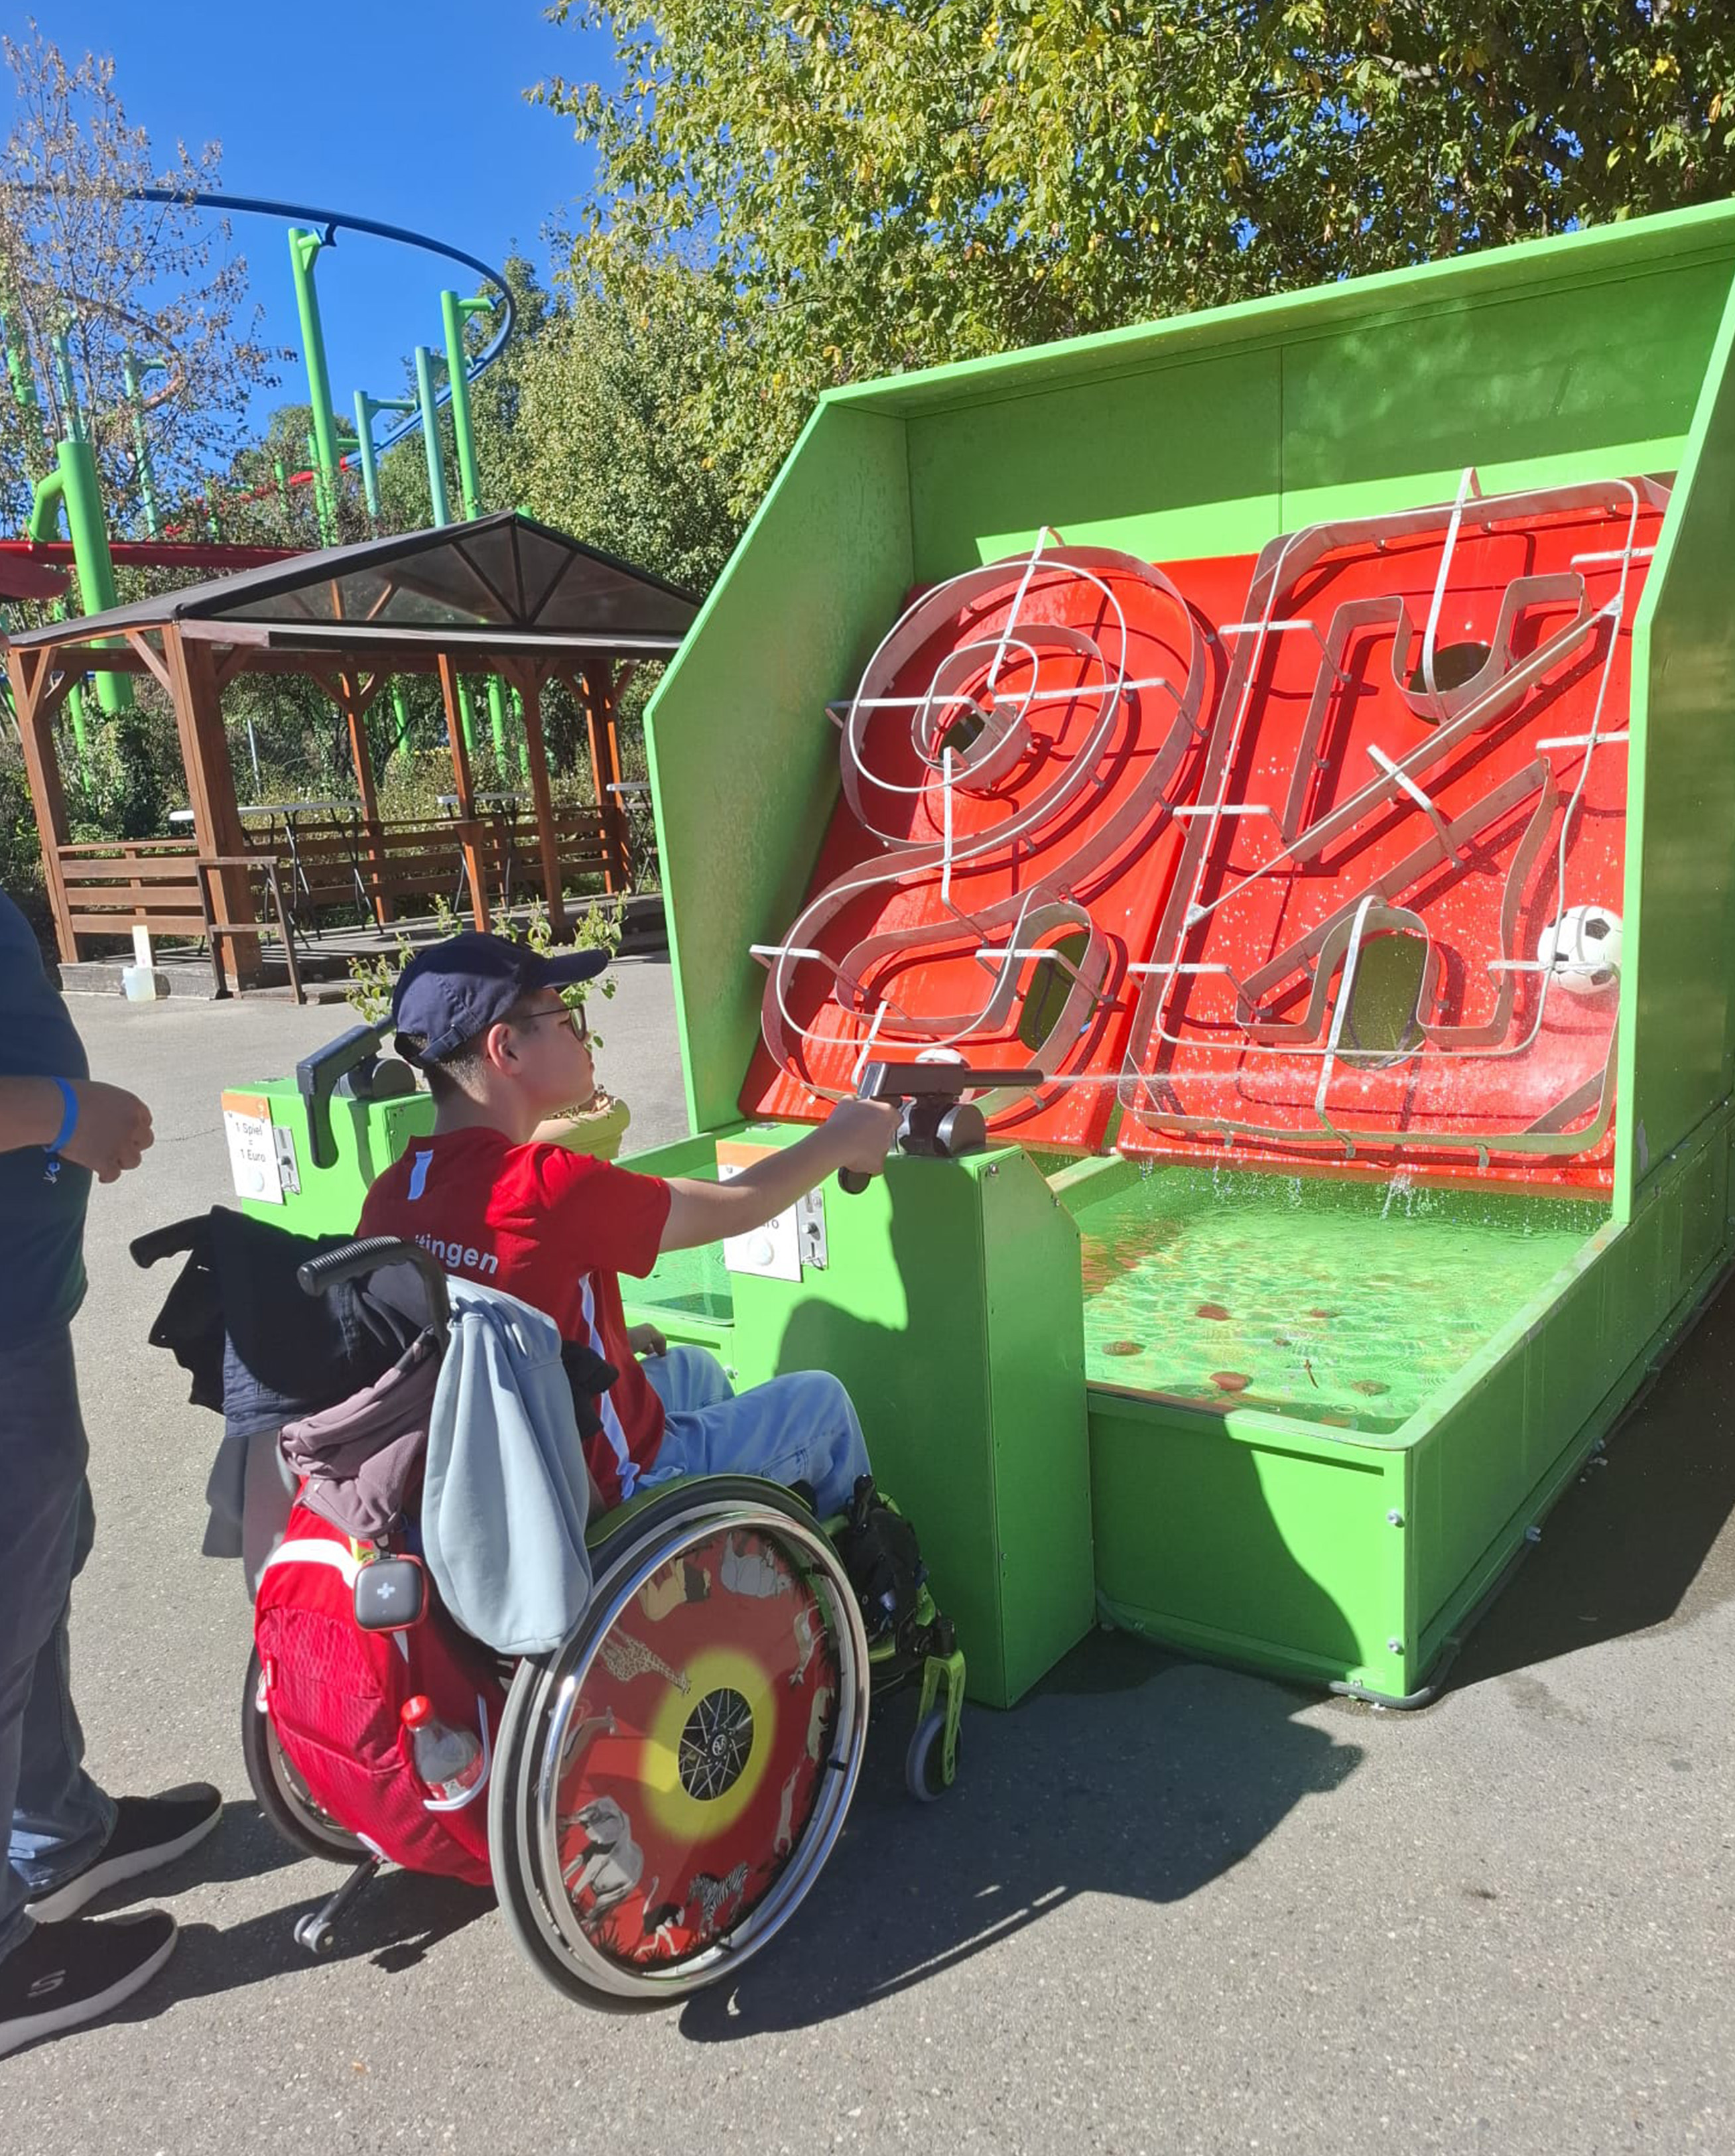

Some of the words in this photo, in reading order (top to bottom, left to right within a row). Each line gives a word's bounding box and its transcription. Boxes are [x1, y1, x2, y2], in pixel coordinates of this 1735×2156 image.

[235, 1122, 240, 1132] 1
[243, 1122, 263, 1136] Spiel
[240, 1149, 245, 1159] 1
[247, 1149, 266, 1162] Euro
